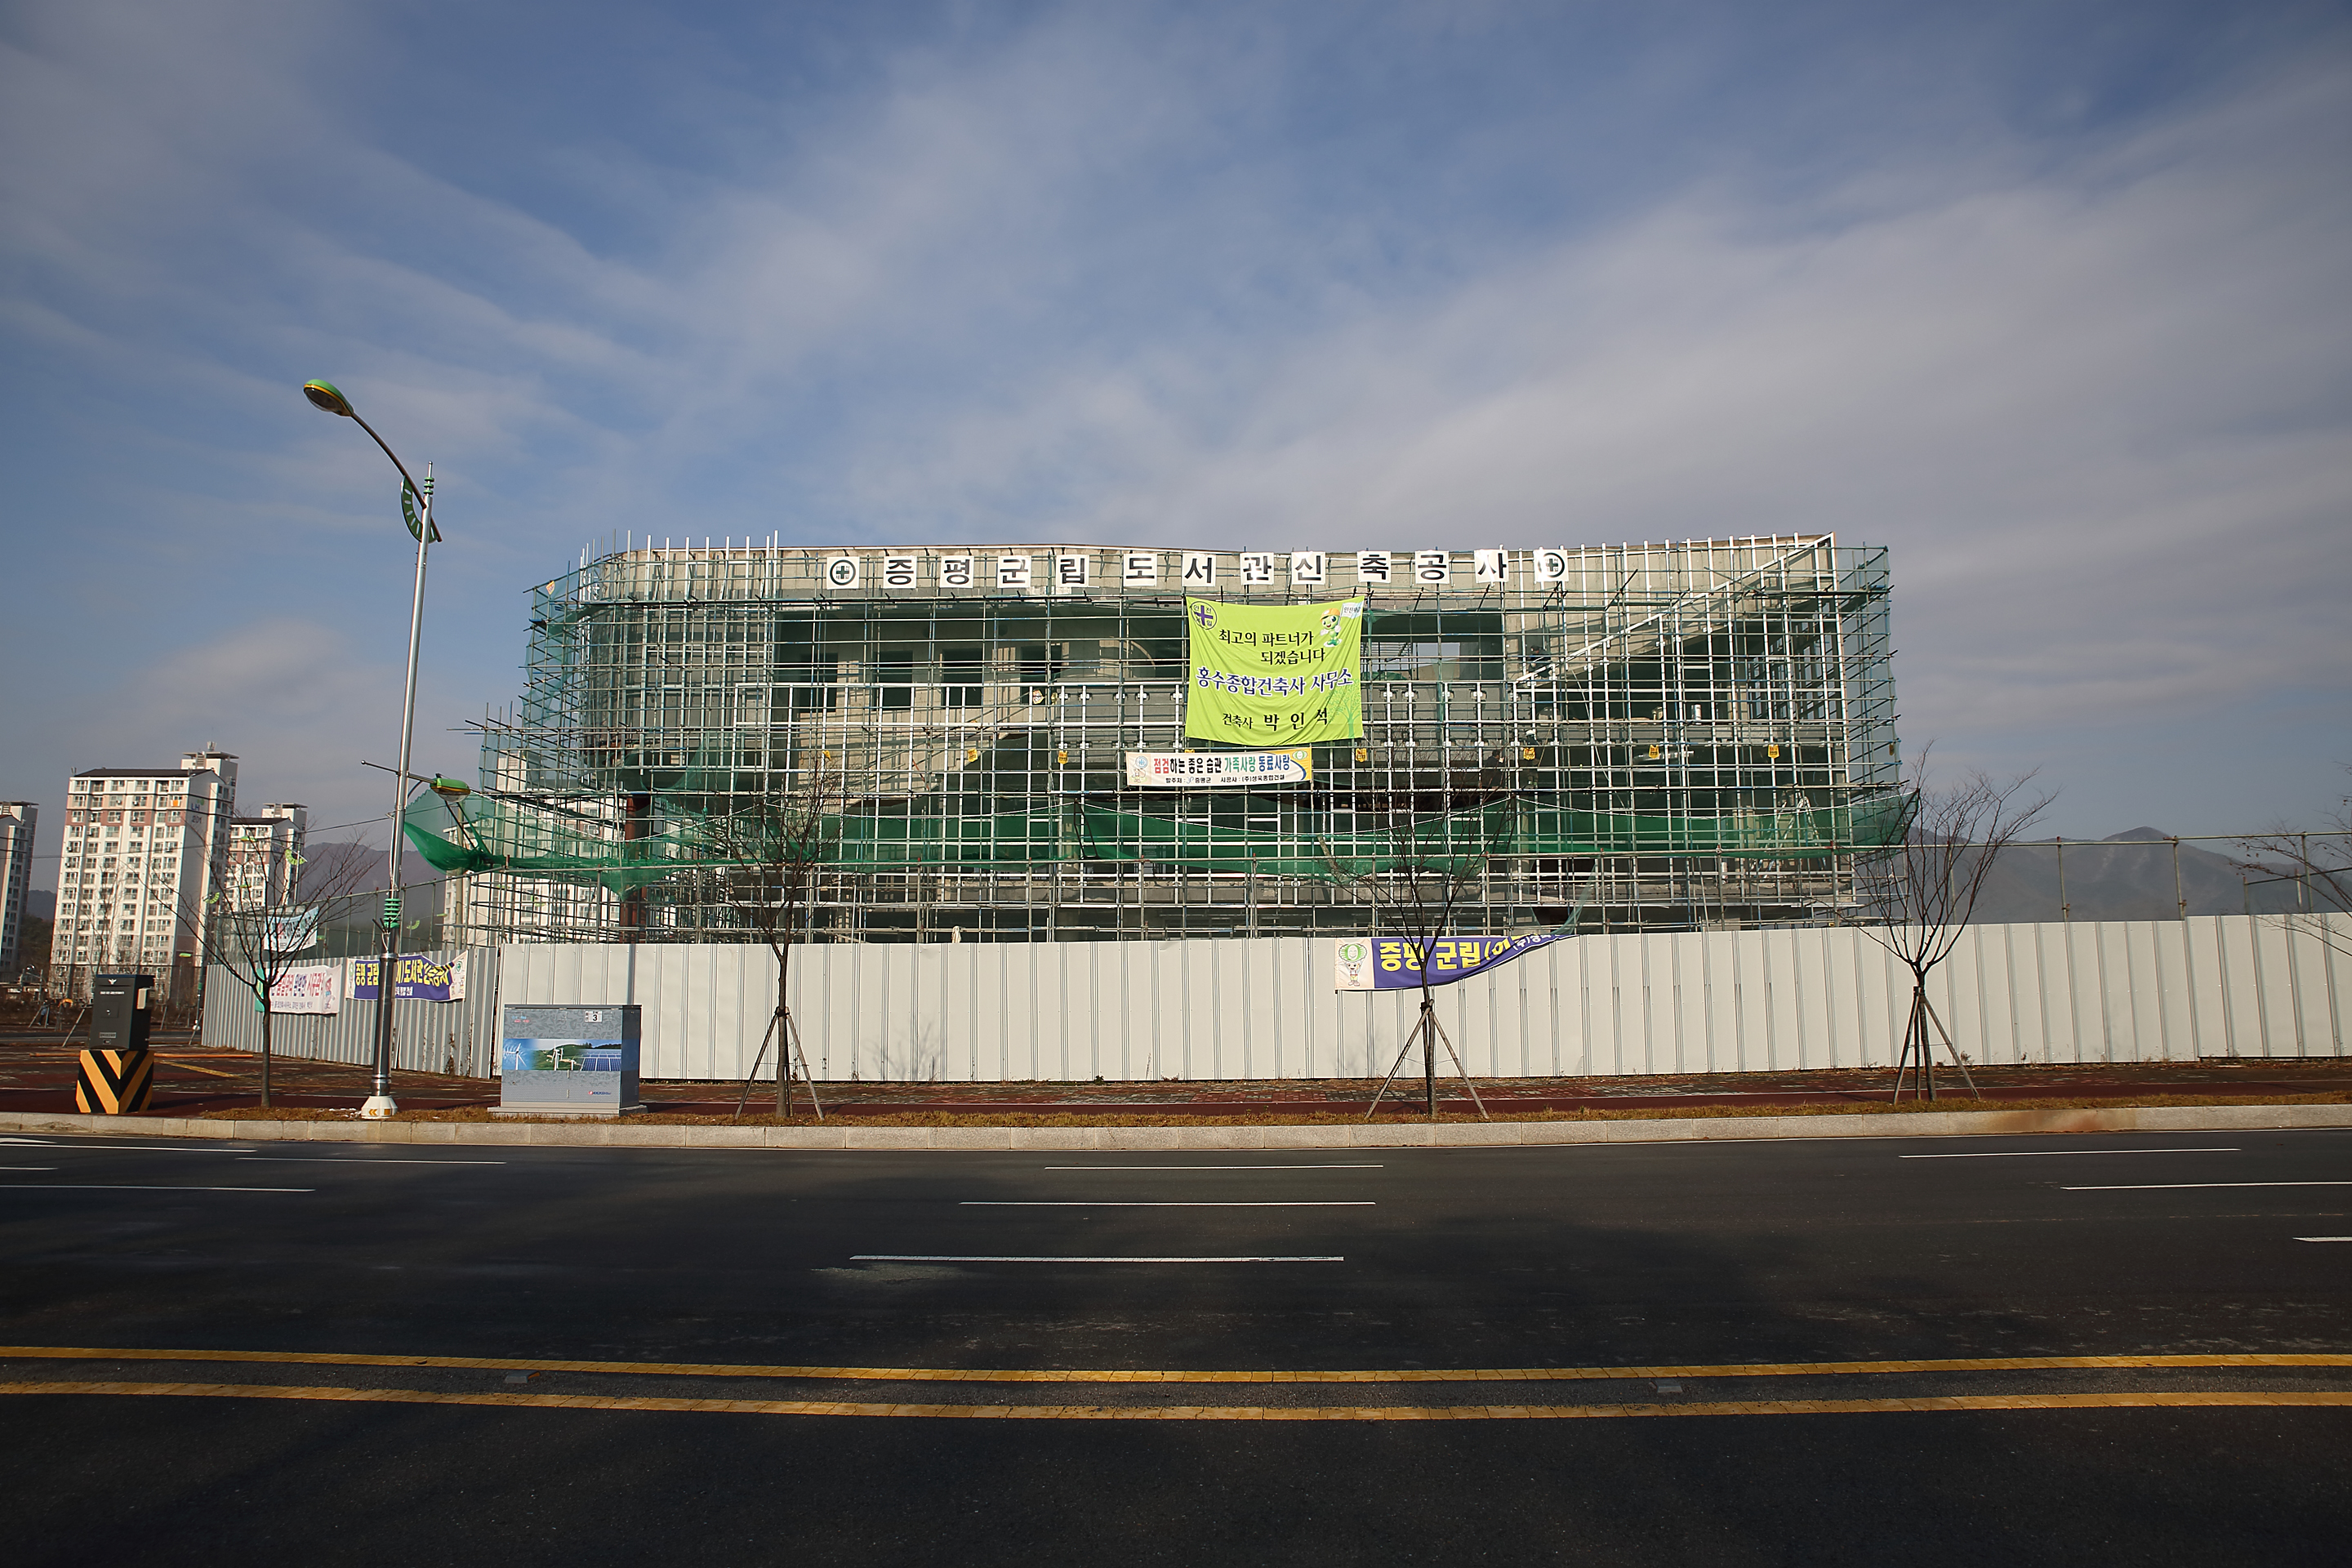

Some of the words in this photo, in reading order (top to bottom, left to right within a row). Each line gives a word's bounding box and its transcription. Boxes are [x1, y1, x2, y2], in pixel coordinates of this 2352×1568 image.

[1218, 630, 1257, 647] 최고의
[1262, 631, 1314, 648] 파트너가
[1260, 648, 1326, 666] 되겠습니다
[1196, 666, 1306, 697] 홍수종합건축사
[1310, 668, 1354, 693] 사무소
[1222, 713, 1254, 730] 건축사
[1153, 758, 1186, 774] 점검하는
[1188, 758, 1204, 774] 좋은
[1206, 757, 1222, 774] 습관
[1224, 756, 1256, 773] 가족사랑
[1258, 755, 1290, 772] 동료사랑
[190, 803, 201, 812] LH
[1379, 942, 1423, 972] 증평
[592, 1013, 598, 1022] 3
